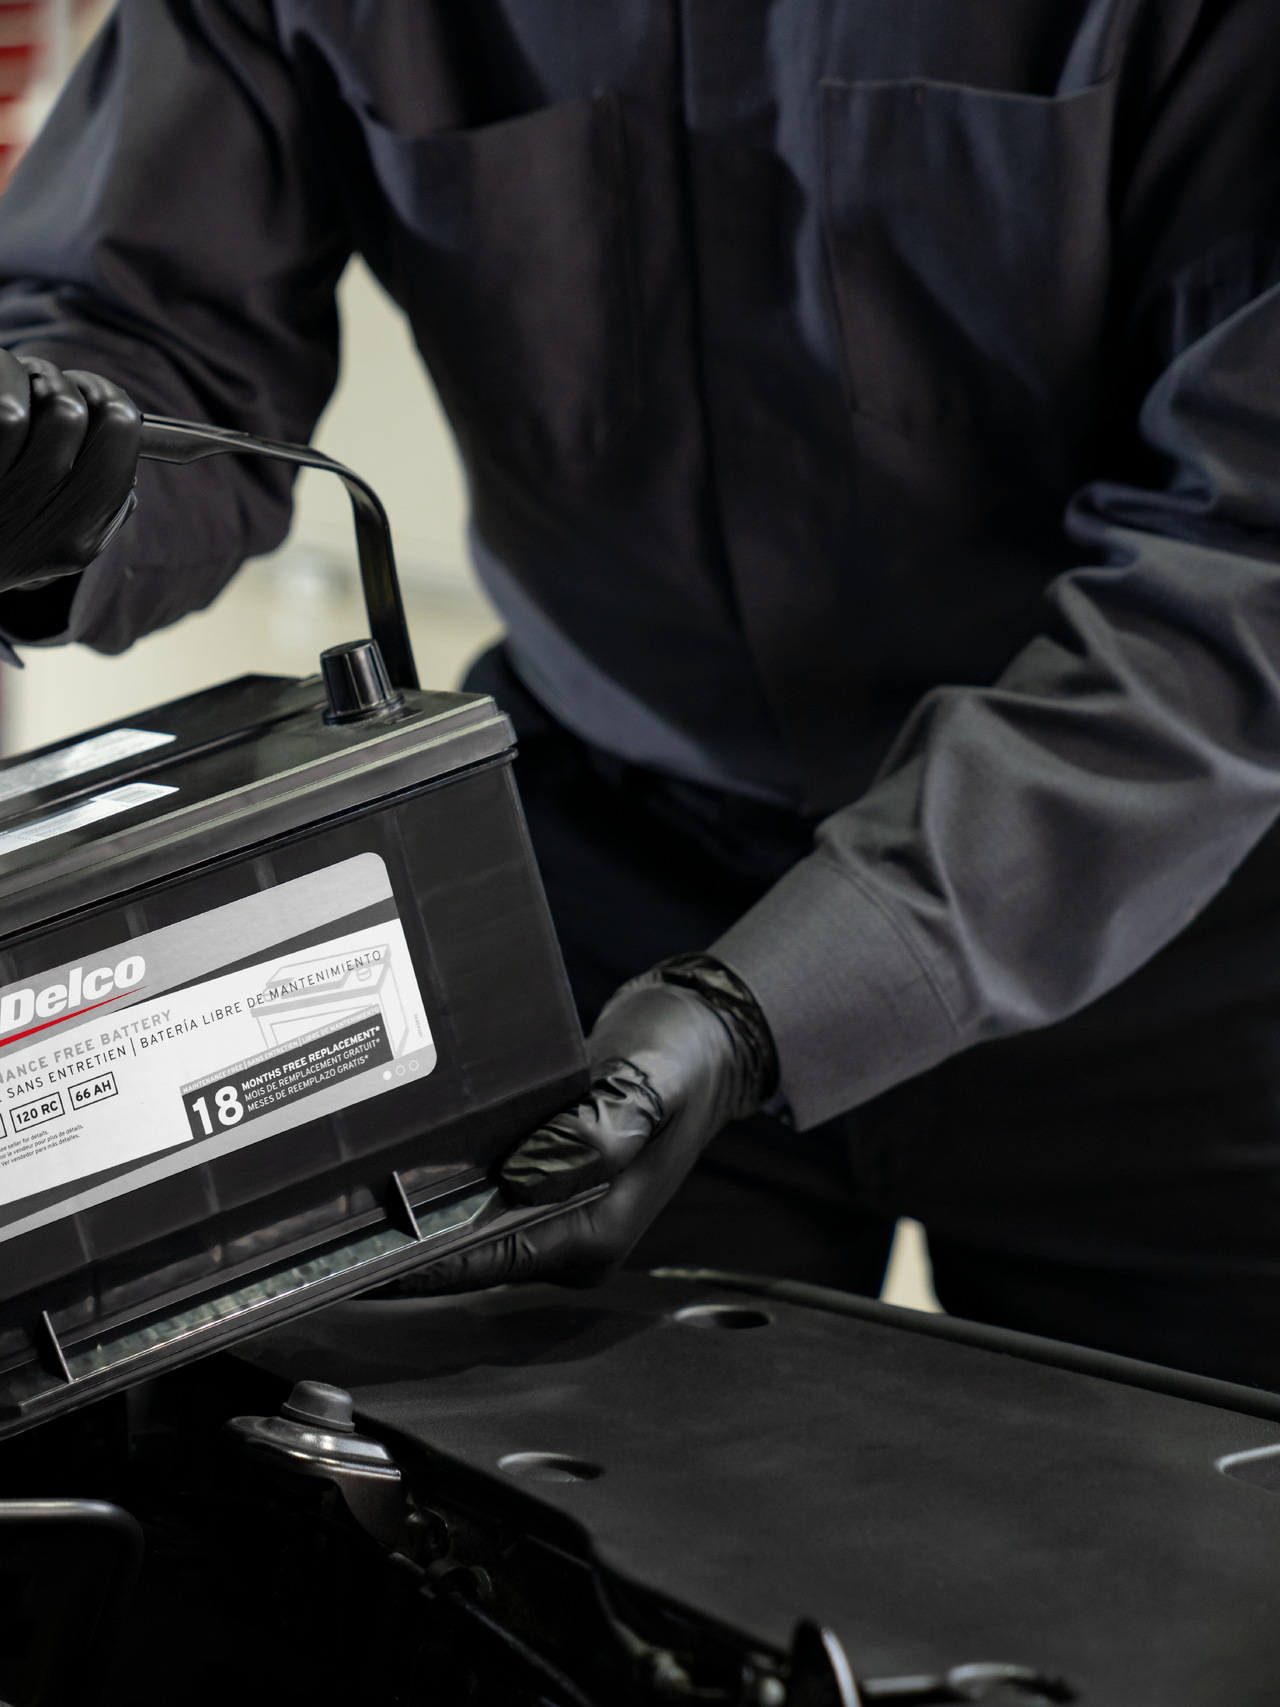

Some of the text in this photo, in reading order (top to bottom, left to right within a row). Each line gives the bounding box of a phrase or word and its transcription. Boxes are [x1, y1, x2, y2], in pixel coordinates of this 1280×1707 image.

[6, 1076, 44, 1099] SANS
[48, 1045, 127, 1083] ENTRETIEN
[140, 1019, 199, 1049] BATERÍA
[202, 1002, 242, 1025] LIBRE
[247, 993, 265, 1009] DE
[269, 950, 382, 1000] MANTENIMIENTO
[54, 1039, 96, 1063] FREE
[101, 1009, 171, 1046] BATTERY
[182, 1006, 379, 1093] MAINTENANCE FREE SANS ENTRETIEN LIBRE DE MANTENIMIENTO
[75, 1080, 112, 1102] 66 AH
[241, 1070, 281, 1091] MONTHS
[283, 1059, 307, 1074] FREE
[244, 1086, 265, 1101] MOIS
[266, 1081, 277, 1092] DE
[278, 1054, 342, 1087] REMPLACEMENT
[247, 1095, 275, 1112] MESES
[275, 1089, 286, 1102] DE
[287, 1068, 336, 1096] REEMPLAZO
[16, 1100, 59, 1125] 120 RC
[192, 1085, 244, 1135] 18
